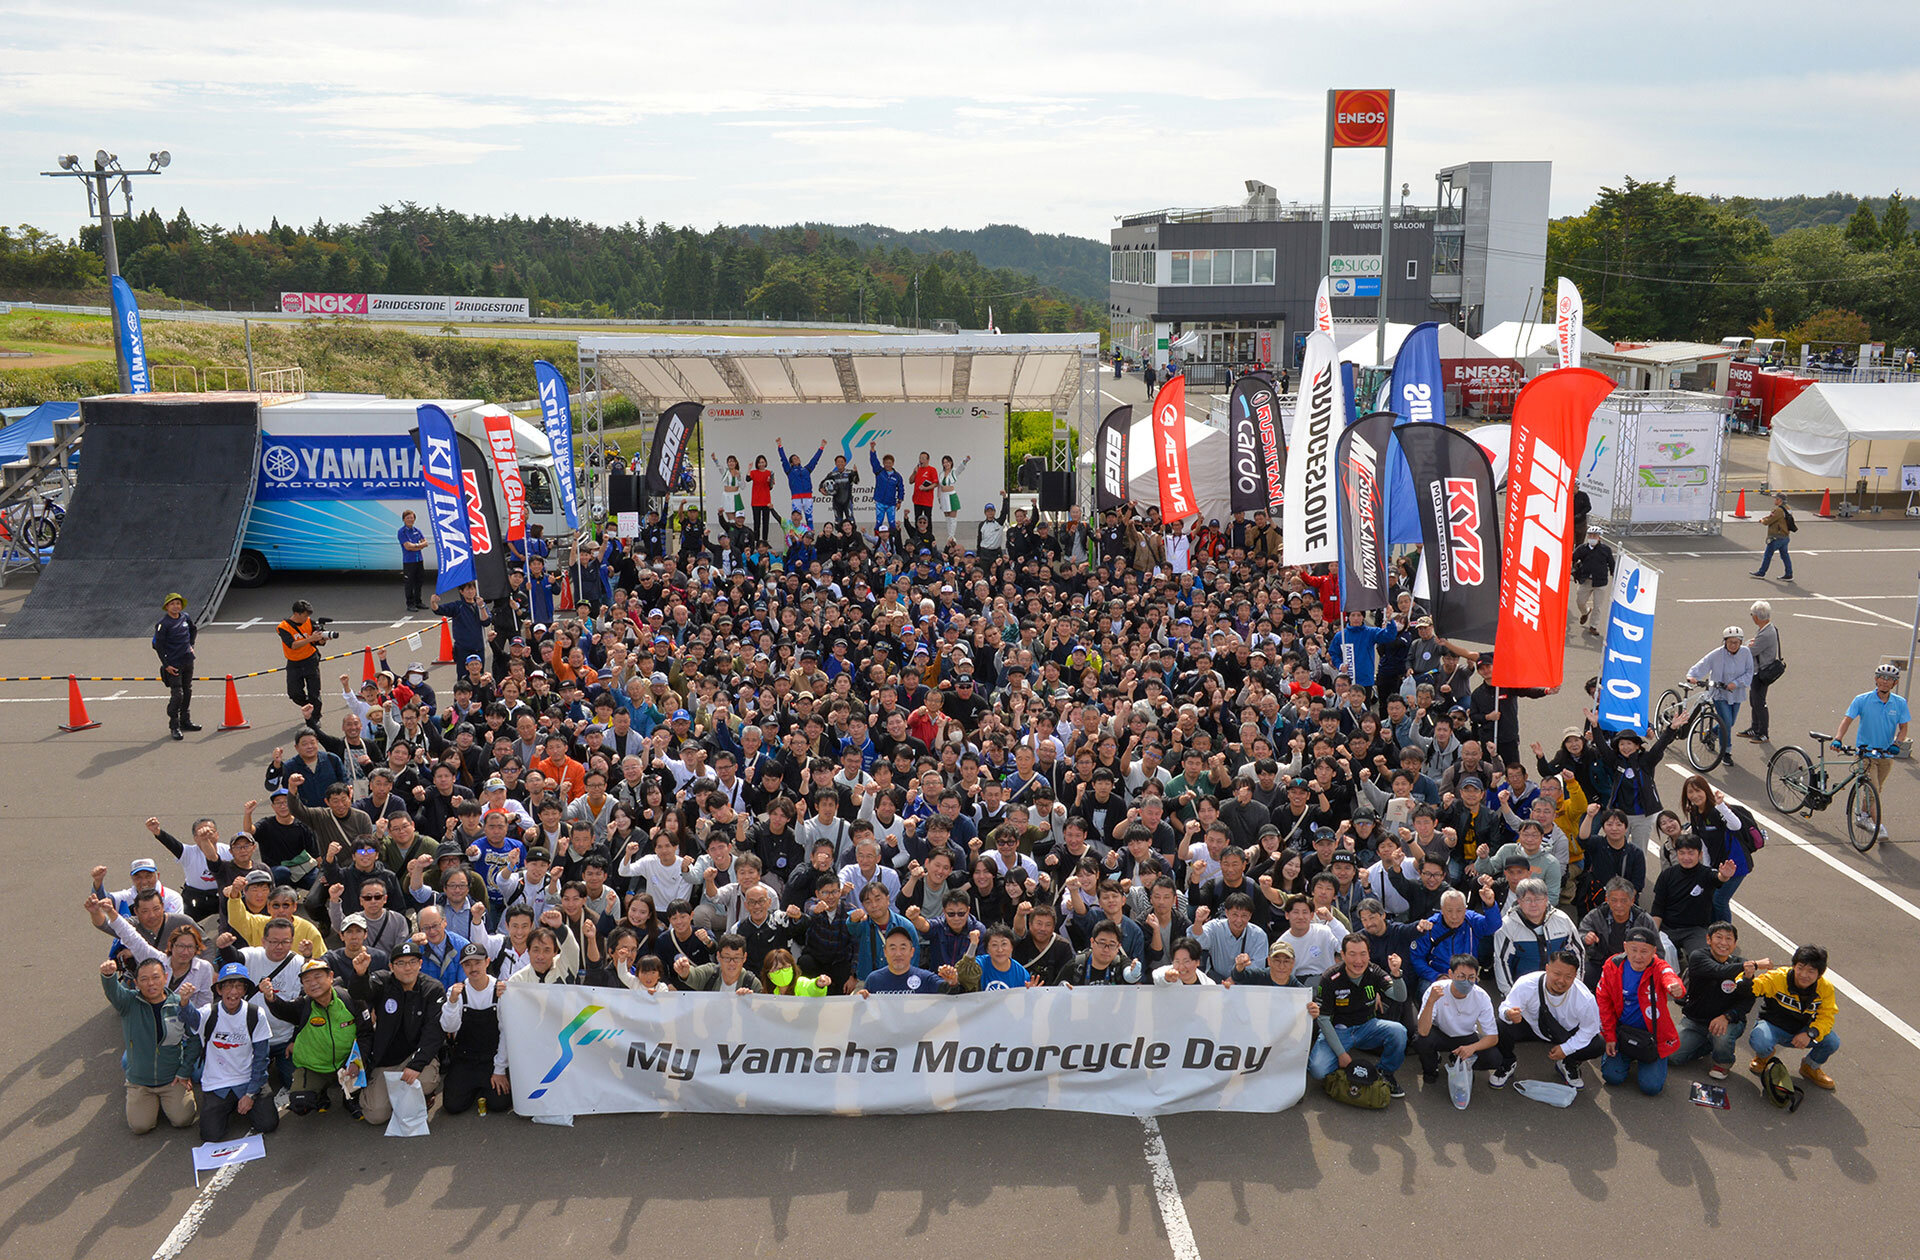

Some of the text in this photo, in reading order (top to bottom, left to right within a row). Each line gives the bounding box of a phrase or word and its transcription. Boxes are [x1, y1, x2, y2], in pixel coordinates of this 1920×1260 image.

[1338, 112, 1385, 124] ENEOS
[1346, 259, 1380, 272] SUGO
[304, 294, 353, 312] NGK
[372, 299, 446, 310] BRIDGESTONE
[454, 301, 525, 312] BRIDGESTONE
[1455, 366, 1510, 378] ENEOS
[1730, 368, 1752, 382] ENEOS
[300, 448, 423, 478] YAMAHA
[658, 414, 684, 486] EDGE
[1105, 426, 1122, 498] EDGE
[1163, 430, 1188, 512] ACTIVE
[1237, 420, 1260, 494] cardo
[1514, 424, 1529, 473] Inoue
[422, 435, 469, 572] KIJIMA
[1508, 480, 1523, 544] Rubber
[1432, 483, 1448, 591] MOTORSPORTS
[1444, 477, 1484, 587] KYB
[1514, 571, 1540, 632] TIRE
[1618, 568, 1631, 595] PLOT
[1605, 615, 1644, 728] PLOT
[626, 1036, 1272, 1082] My Yamaha Motorcycle Day
